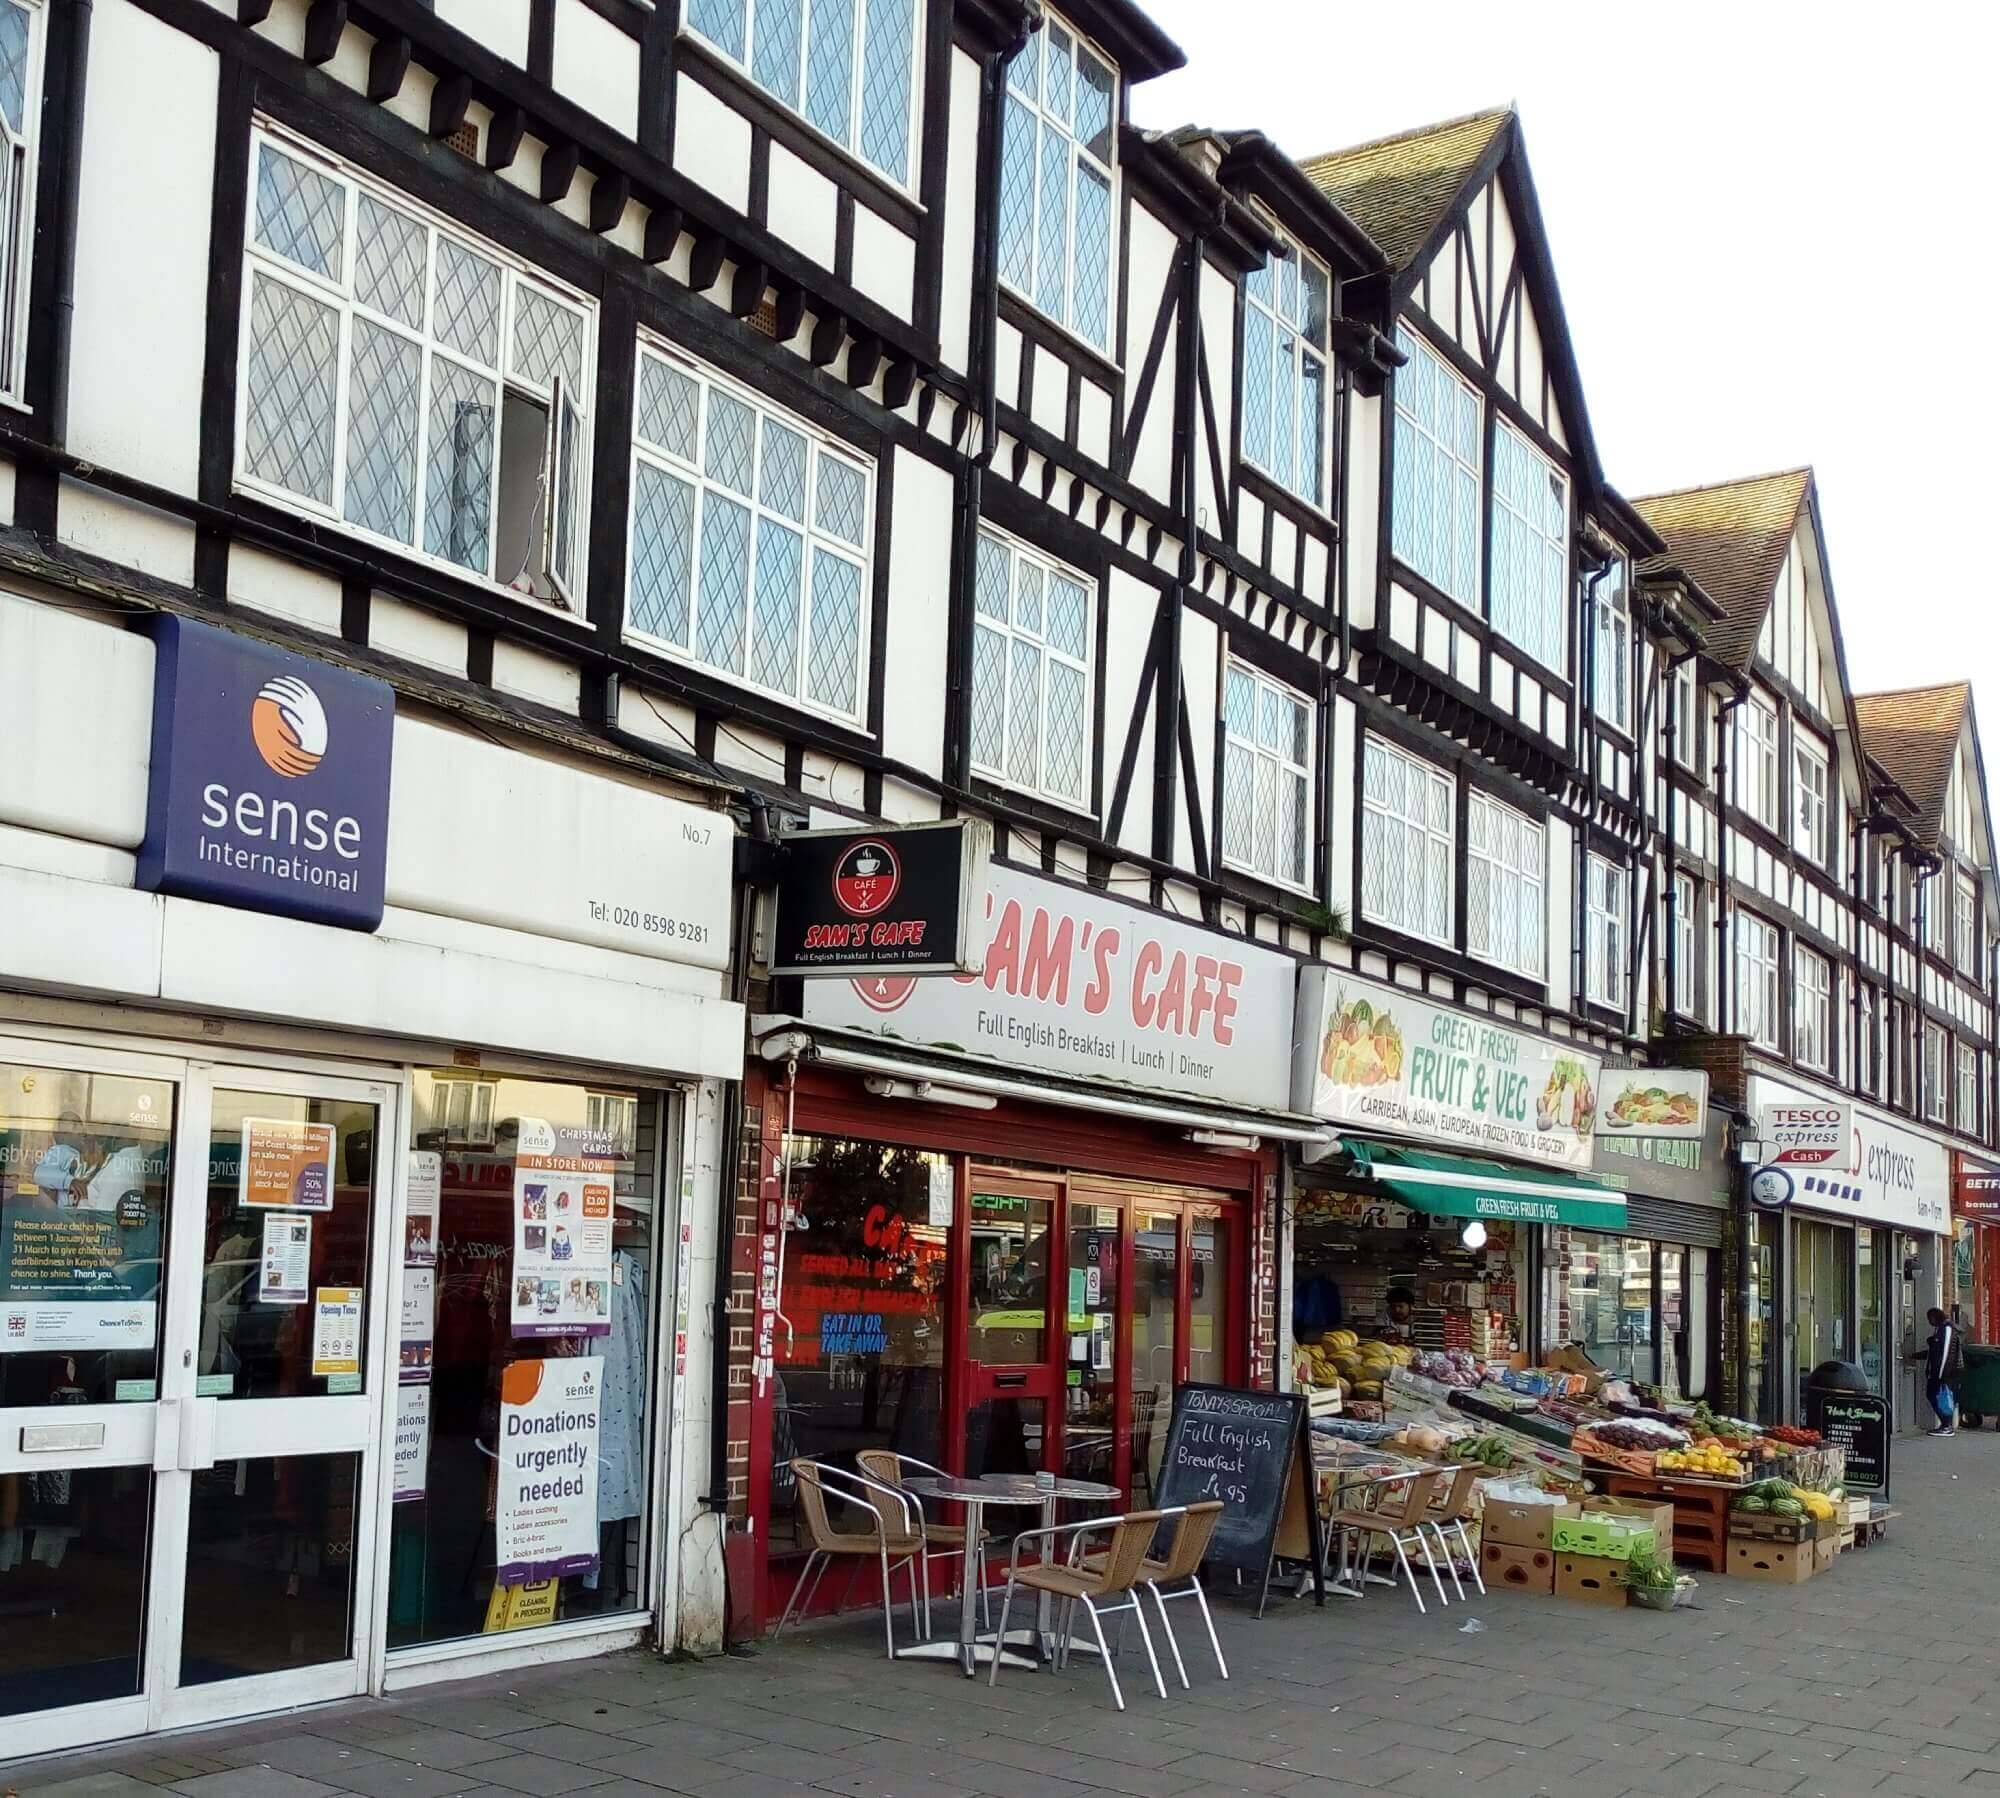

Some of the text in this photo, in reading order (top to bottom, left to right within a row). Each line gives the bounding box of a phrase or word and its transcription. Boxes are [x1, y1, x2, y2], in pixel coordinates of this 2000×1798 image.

[201, 783, 361, 859] sense
[682, 823, 711, 846] No.7
[199, 835, 359, 893] International
[588, 900, 708, 943] Tel: 020 8598 9281
[804, 920, 927, 949] SAM'S CAFE
[835, 951, 868, 960] Breakfast
[877, 951, 899, 960] Lunch
[908, 950, 932, 959] Dinner
[952, 892, 1244, 1047] AM'S CAFE
[977, 1010, 1214, 1080] Full English Breakfast Lunch Dinner
[1432, 1013, 1519, 1066] GREEN FRESH
[1410, 1046, 1529, 1122] FRUIT & VEG
[129, 1112, 159, 1124] sense
[1772, 1110, 1840, 1122] TESCO
[1360, 1096, 1411, 1126] CARRIBEAN,
[1412, 1107, 1439, 1131] ASIAN,
[1440, 1114, 1481, 1138] EUROPEAN
[1482, 1124, 1510, 1145] FROZEN
[1510, 1130, 1529, 1147] FOOD
[1537, 1136, 1567, 1156] GROCERY
[524, 1135, 550, 1147] sense
[560, 1128, 614, 1143] CHRISTMAS
[1775, 1131, 1838, 1146] express
[261, 1151, 276, 1159] sale
[582, 1143, 613, 1155] CARDS
[1791, 1150, 1821, 1160] Cash
[530, 1158, 603, 1172] IN STORE NOW
[1868, 1141, 1914, 1200] express
[306, 1179, 321, 1189] 50%
[1965, 1178, 2000, 1189] BETF
[1476, 1197, 1500, 1214] GREEN
[1500, 1200, 1519, 1217] FRESH
[1520, 1202, 1539, 1217] FRUIT
[1545, 1204, 1559, 1219] VEG
[14, 1220, 39, 1230] Please
[41, 1220, 68, 1231] donate
[69, 1222, 94, 1231] clothes
[13, 1233, 47, 1243] between
[55, 1234, 85, 1244] January
[13, 1246, 23, 1254] 31
[25, 1246, 50, 1254] March
[62, 1247, 76, 1256] give
[78, 1247, 106, 1256] children
[11, 1257, 65, 1267] deafblindness
[67, 1258, 73, 1266] in
[75, 1258, 98, 1269] Kenya
[11, 1269, 39, 1278] chance
[41, 1270, 48, 1278] to
[73, 1269, 97, 1279] Thank
[320, 1304, 357, 1317] Opening Times
[822, 1314, 848, 1332] EAT
[849, 1314, 862, 1333] IN
[864, 1314, 882, 1333] OR
[565, 1385, 595, 1397] sense
[507, 1410, 596, 1437] Donations
[1181, 1420, 1271, 1452] Full English
[516, 1442, 588, 1473] urgently
[1178, 1445, 1246, 1474] Breakfast
[520, 1474, 584, 1503] needed
[513, 1509, 534, 1517] Ladies
[512, 1518, 568, 1531] Ladies accessories
[513, 1545, 562, 1559] Books and media
[519, 1596, 548, 1608] CLEANING
[520, 1607, 551, 1619] PROGRESS
